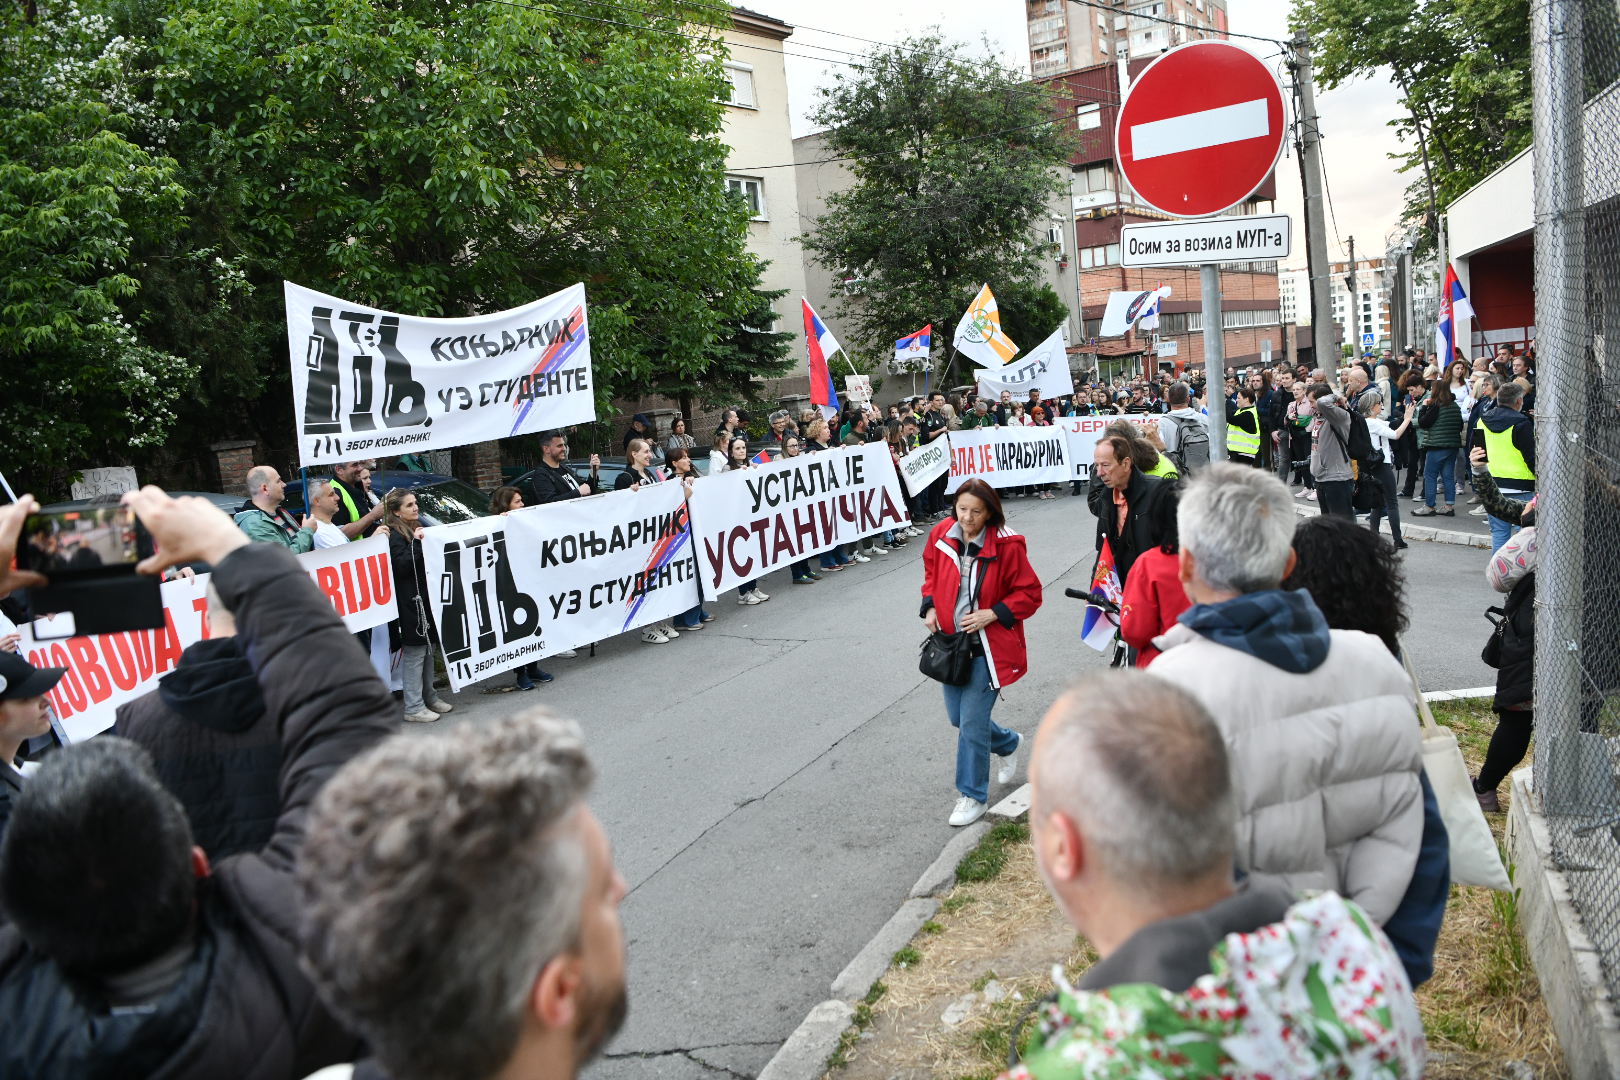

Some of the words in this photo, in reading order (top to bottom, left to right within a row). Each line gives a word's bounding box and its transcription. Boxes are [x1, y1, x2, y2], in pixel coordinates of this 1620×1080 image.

[1129, 238, 1162, 255] Осим
[1165, 239, 1181, 253] за
[1184, 236, 1232, 252] возила
[1236, 229, 1282, 249] МУП-а
[430, 316, 575, 362] КОЊАРНИК
[437, 386, 474, 413] УЗ
[479, 367, 589, 407] СТУДЕНТЕ
[346, 438, 374, 452] ЗБОР
[375, 431, 431, 448] КОЊАРНИК!
[948, 446, 977, 478] АЛА
[979, 443, 994, 473] ЈЕ
[995, 438, 1064, 471] КАРАБУРМА
[745, 459, 840, 513] УСТАЛА
[845, 454, 865, 487] ЈЕ
[540, 508, 687, 568] КОЊАРНИК
[704, 485, 911, 590] УСТАНИЧКА.
[315, 552, 392, 617] RIJU
[549, 589, 581, 620] УЗ
[590, 557, 694, 609] СТУДЕНТЕ
[474, 658, 495, 674] ЗБОР
[496, 641, 546, 666] КОЊАРНИК!
